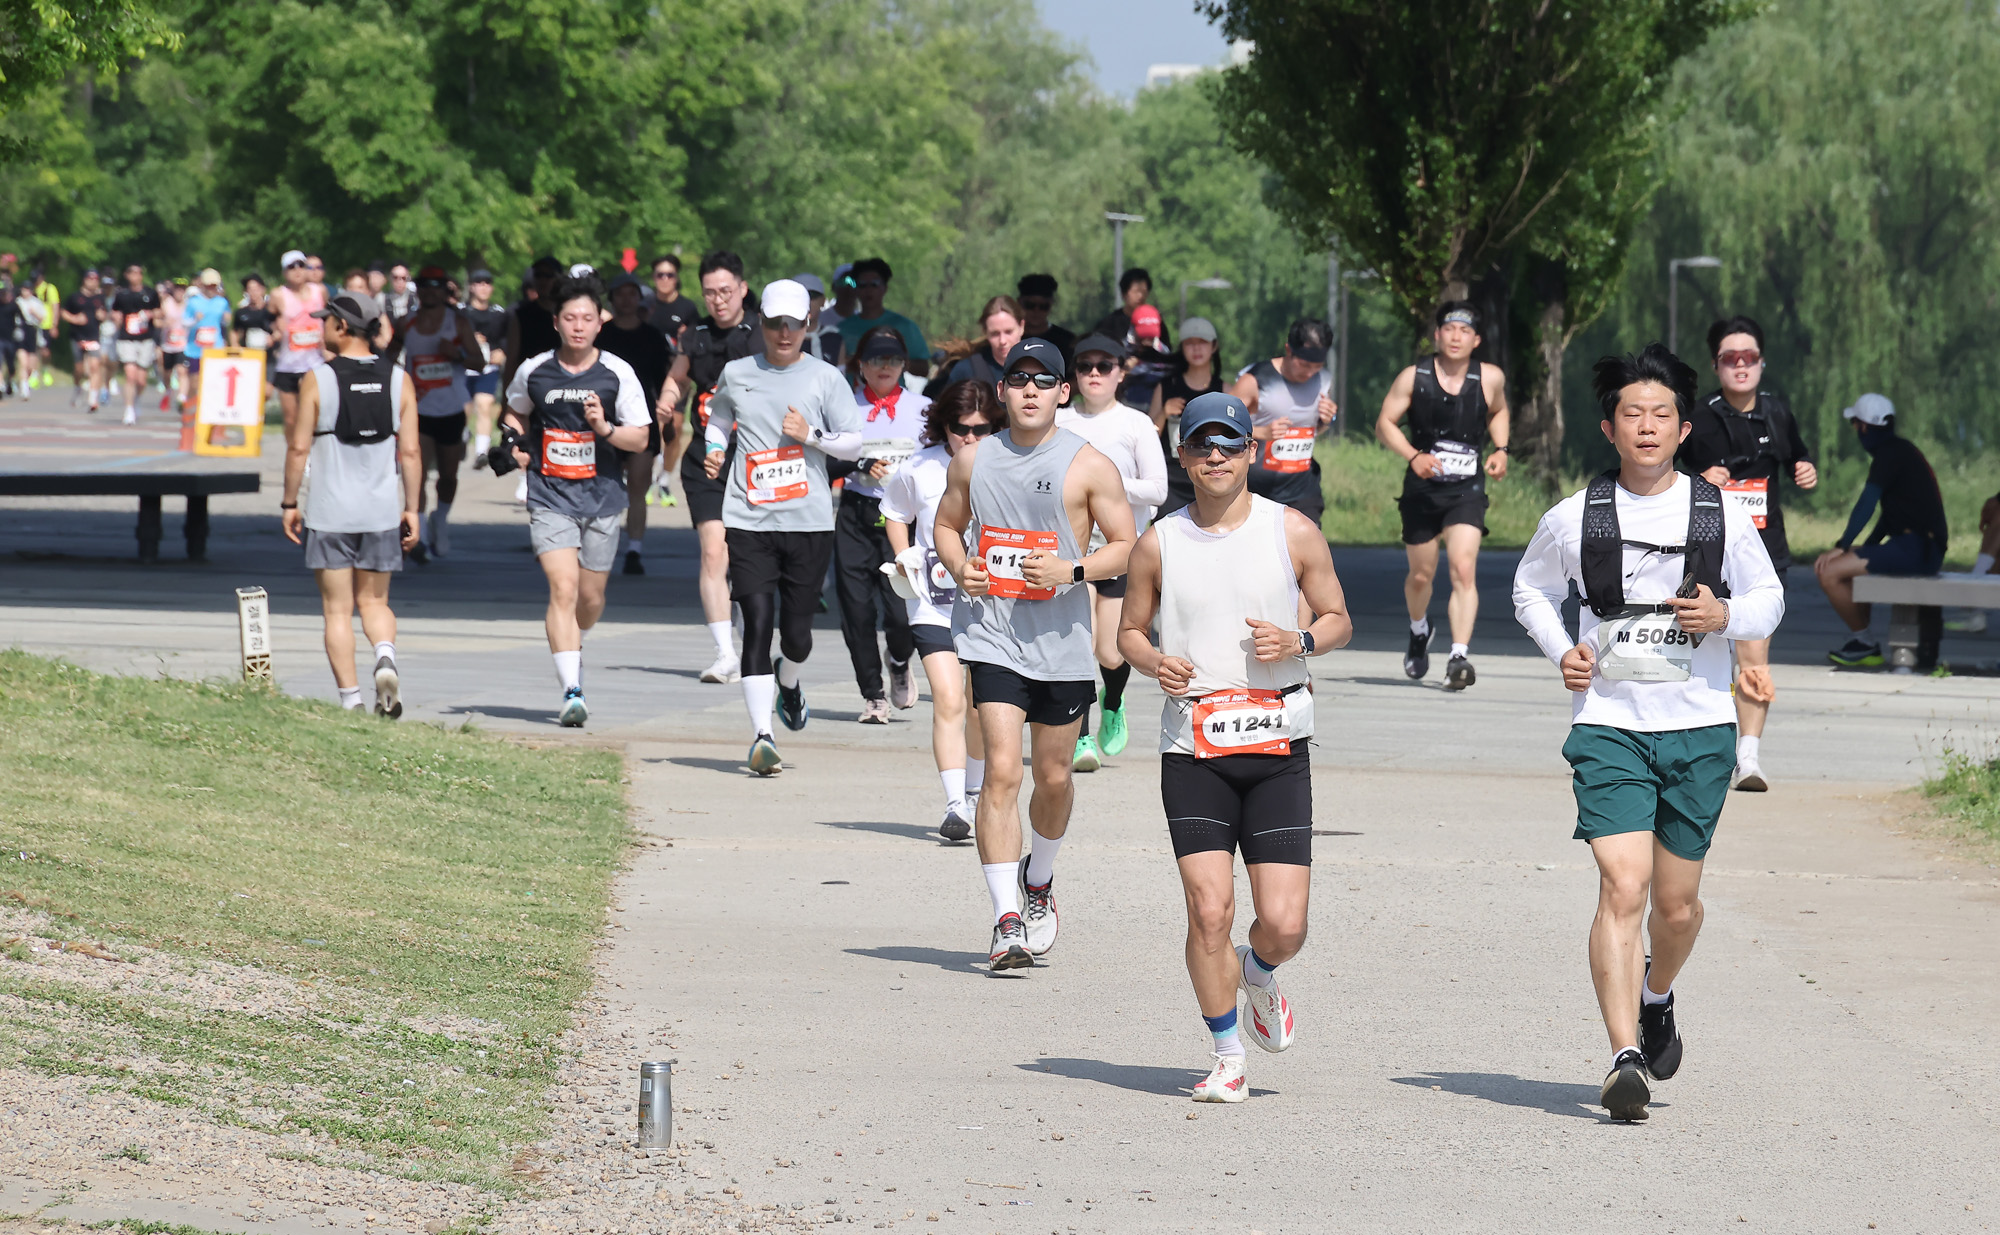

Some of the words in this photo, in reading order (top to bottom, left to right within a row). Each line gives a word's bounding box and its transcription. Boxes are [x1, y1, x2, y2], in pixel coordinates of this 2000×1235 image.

[756, 472, 764, 481] M
[768, 463, 802, 478] 2147
[1735, 496, 1764, 506] 760
[984, 530, 1010, 540] BURNING
[1011, 533, 1026, 541] RUN
[992, 554, 1003, 565] M
[937, 570, 946, 579] W
[1616, 631, 1631, 643] M
[1635, 628, 1689, 646] 5085
[1212, 722, 1225, 733] M
[1232, 714, 1283, 733] 1241
